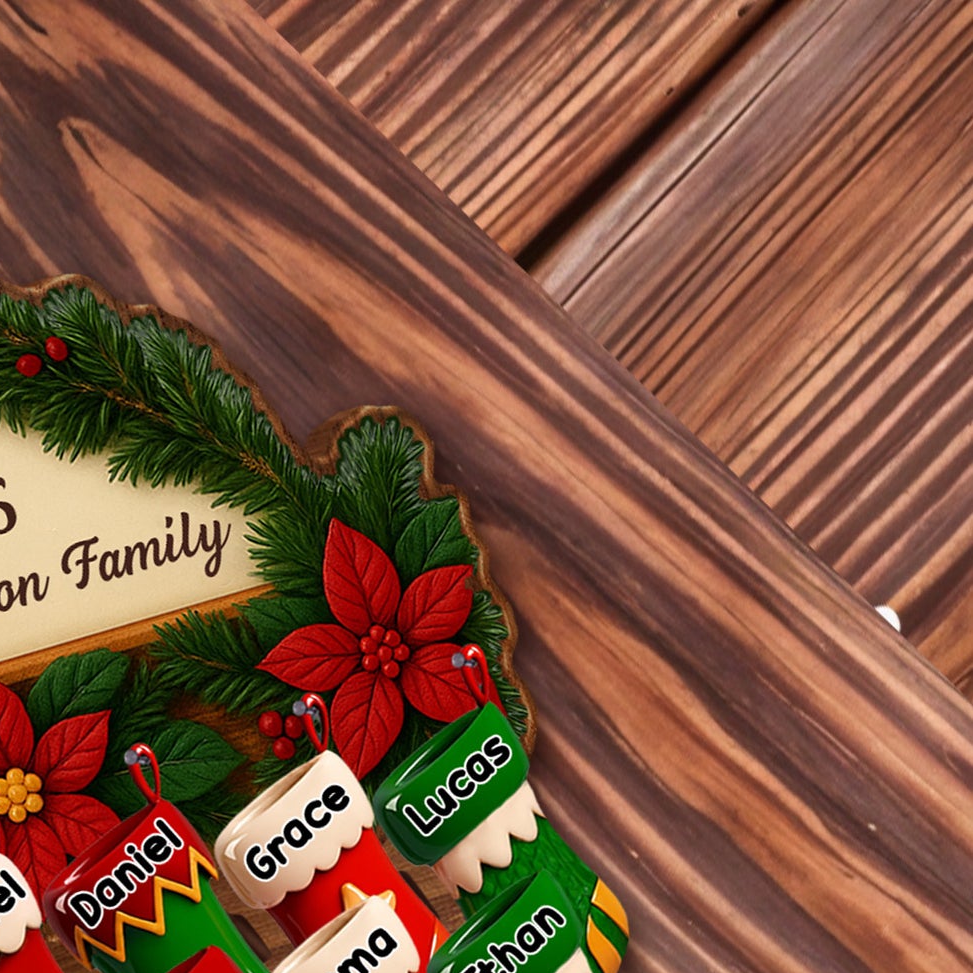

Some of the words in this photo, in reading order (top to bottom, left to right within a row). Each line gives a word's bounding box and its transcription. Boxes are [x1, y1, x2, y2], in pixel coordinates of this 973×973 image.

[60, 512, 231, 589] Family
[244, 783, 351, 881] Grace
[403, 734, 512, 836] Lucas
[69, 817, 184, 929] Daniel
